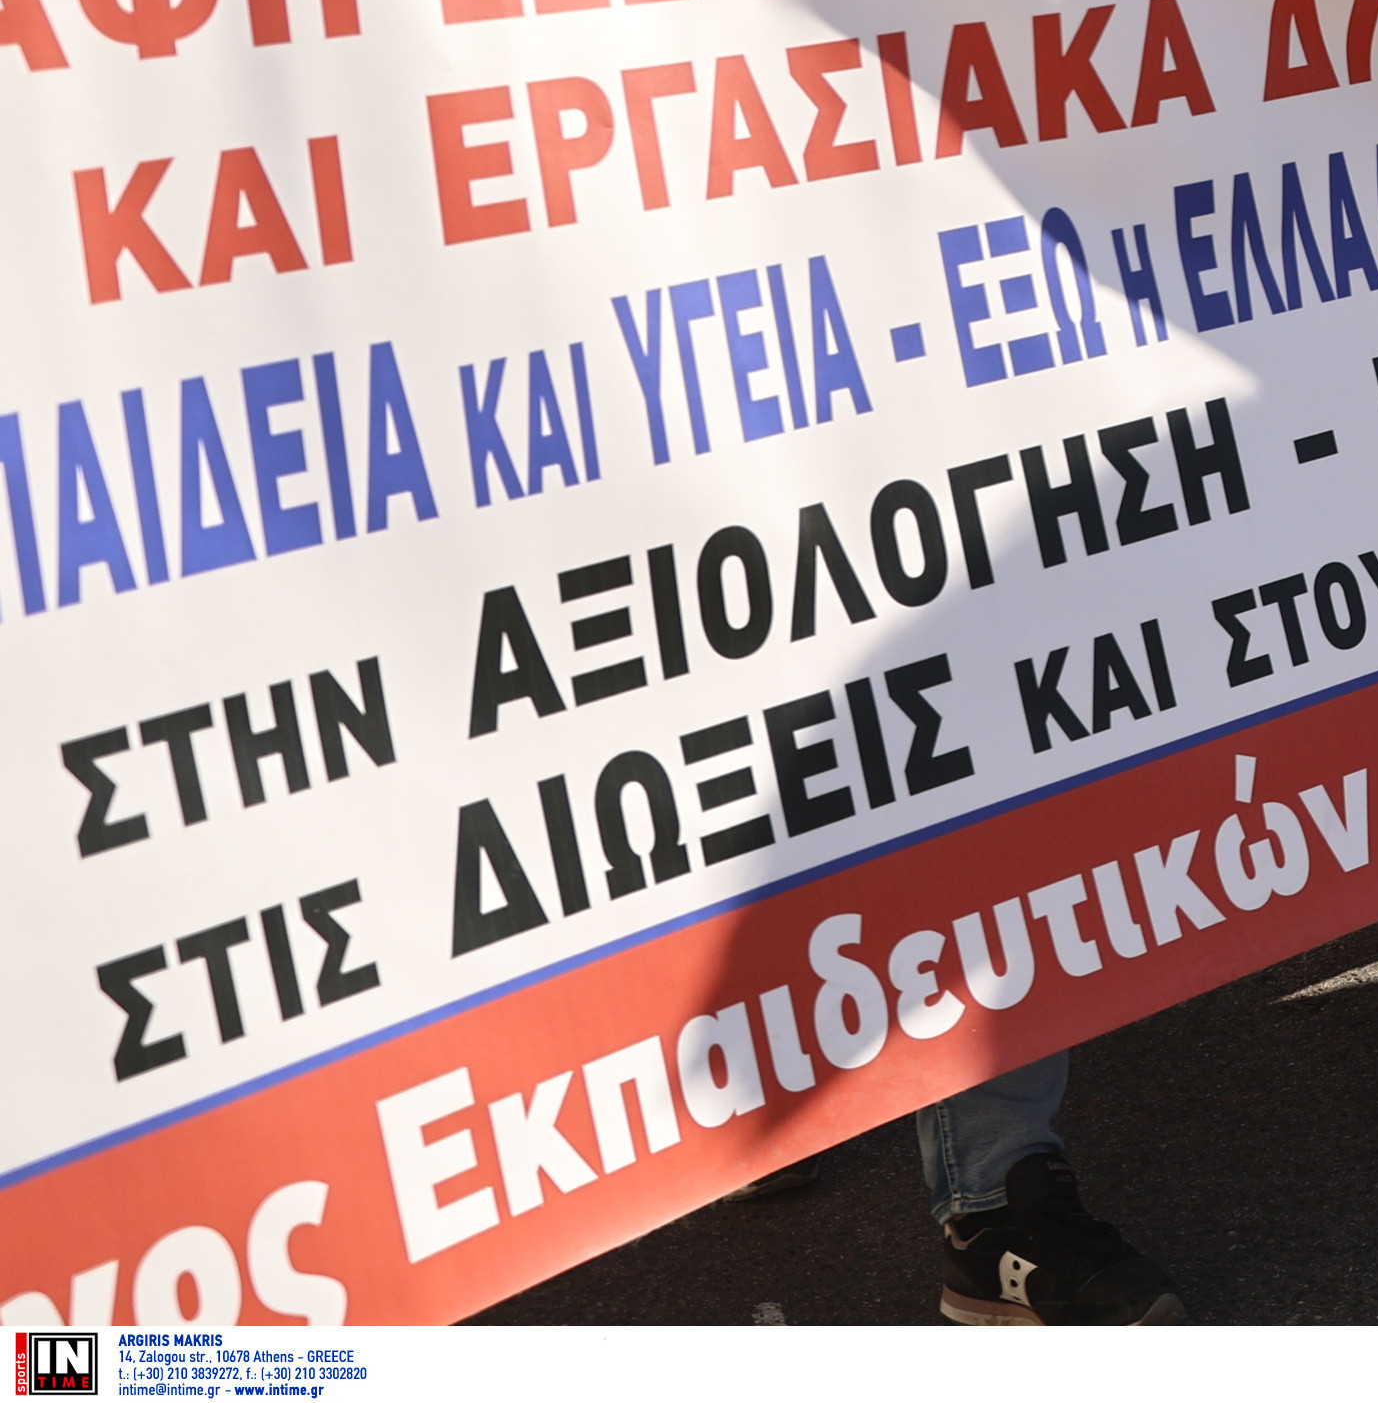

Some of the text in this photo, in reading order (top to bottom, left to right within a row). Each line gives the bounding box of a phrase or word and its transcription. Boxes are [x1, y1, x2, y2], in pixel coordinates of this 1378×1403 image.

[72, 135, 354, 306] ΚΑΙ
[459, 342, 602, 508] ΚΑΙ
[610, 255, 873, 466] ΥΓΕΙΑ
[890, 322, 926, 363] -
[937, 206, 1107, 388] ΕΞΩ
[1111, 223, 1168, 347] Η
[60, 655, 397, 859] ΣΤΗΝ
[468, 397, 1251, 739] ΑΞΙΟΛΟΓΗΣΗ
[1294, 429, 1339, 465] -
[95, 877, 381, 1083] ΣΤΙΣ
[451, 652, 975, 959] ΔΙΩΞΕΙΣ
[1014, 619, 1177, 754] ΚΑΙ
[376, 754, 1370, 1265] Εκπαιδευτικών
